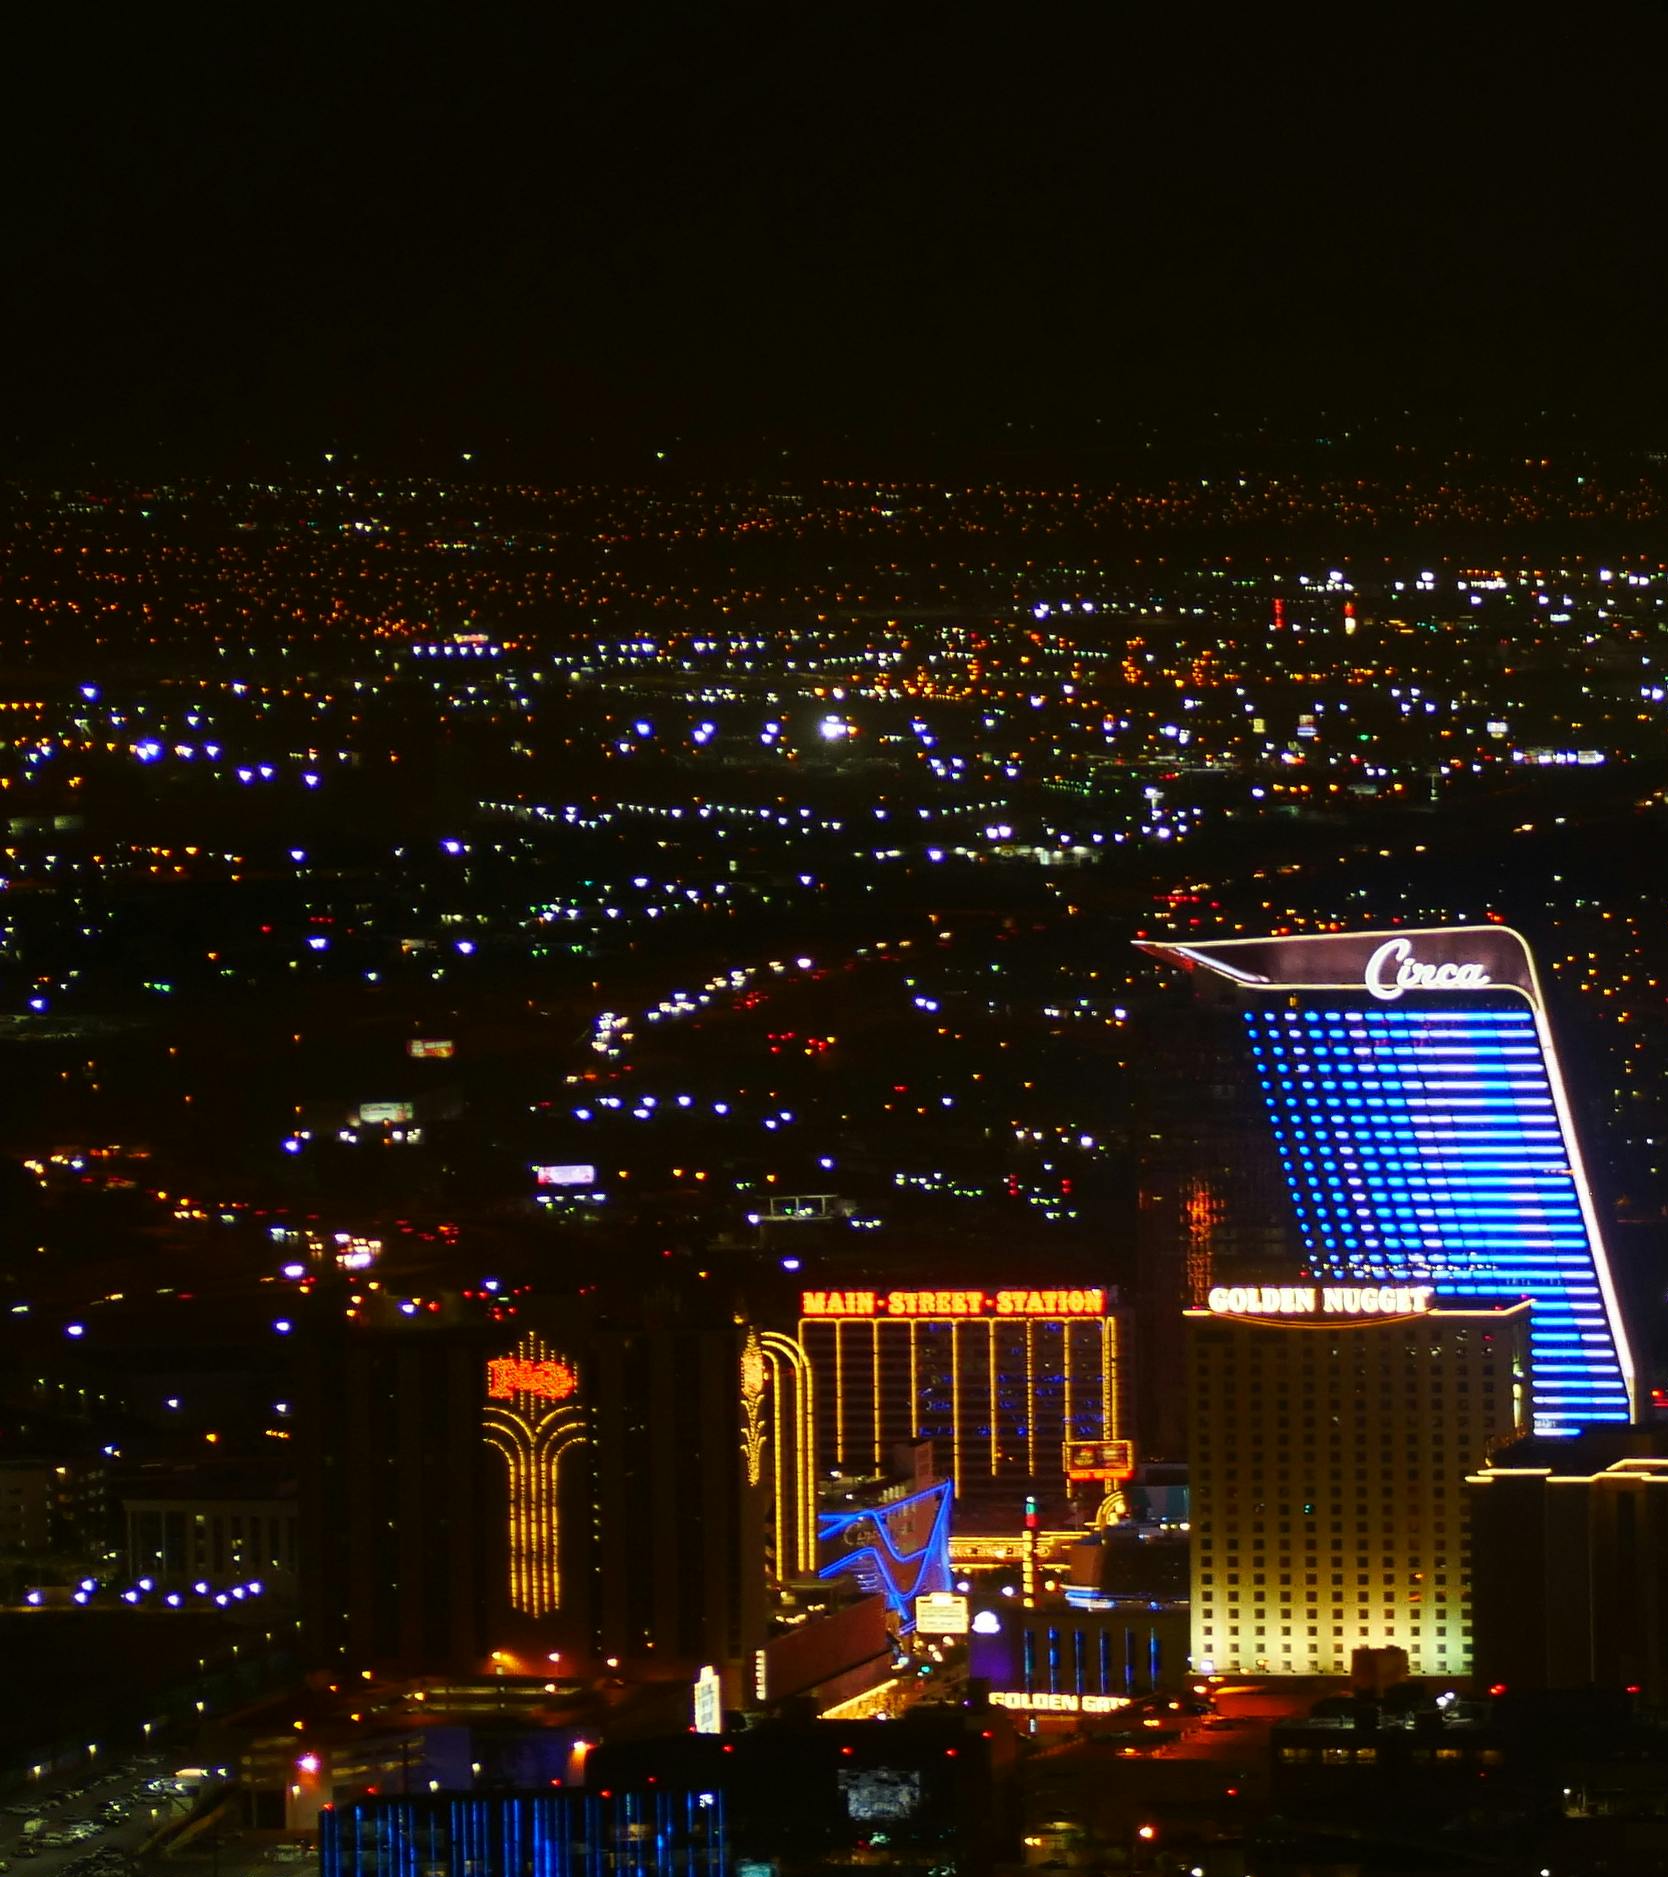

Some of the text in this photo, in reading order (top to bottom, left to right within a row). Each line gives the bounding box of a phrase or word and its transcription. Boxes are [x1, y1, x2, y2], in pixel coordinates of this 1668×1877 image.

[1365, 938, 1491, 1000] Circa
[802, 1289, 1102, 1314] MAIN STREET STATION
[1208, 1286, 1431, 1313] GOLDEN NUGGET
[988, 1692, 1078, 1711] GOLDEN
